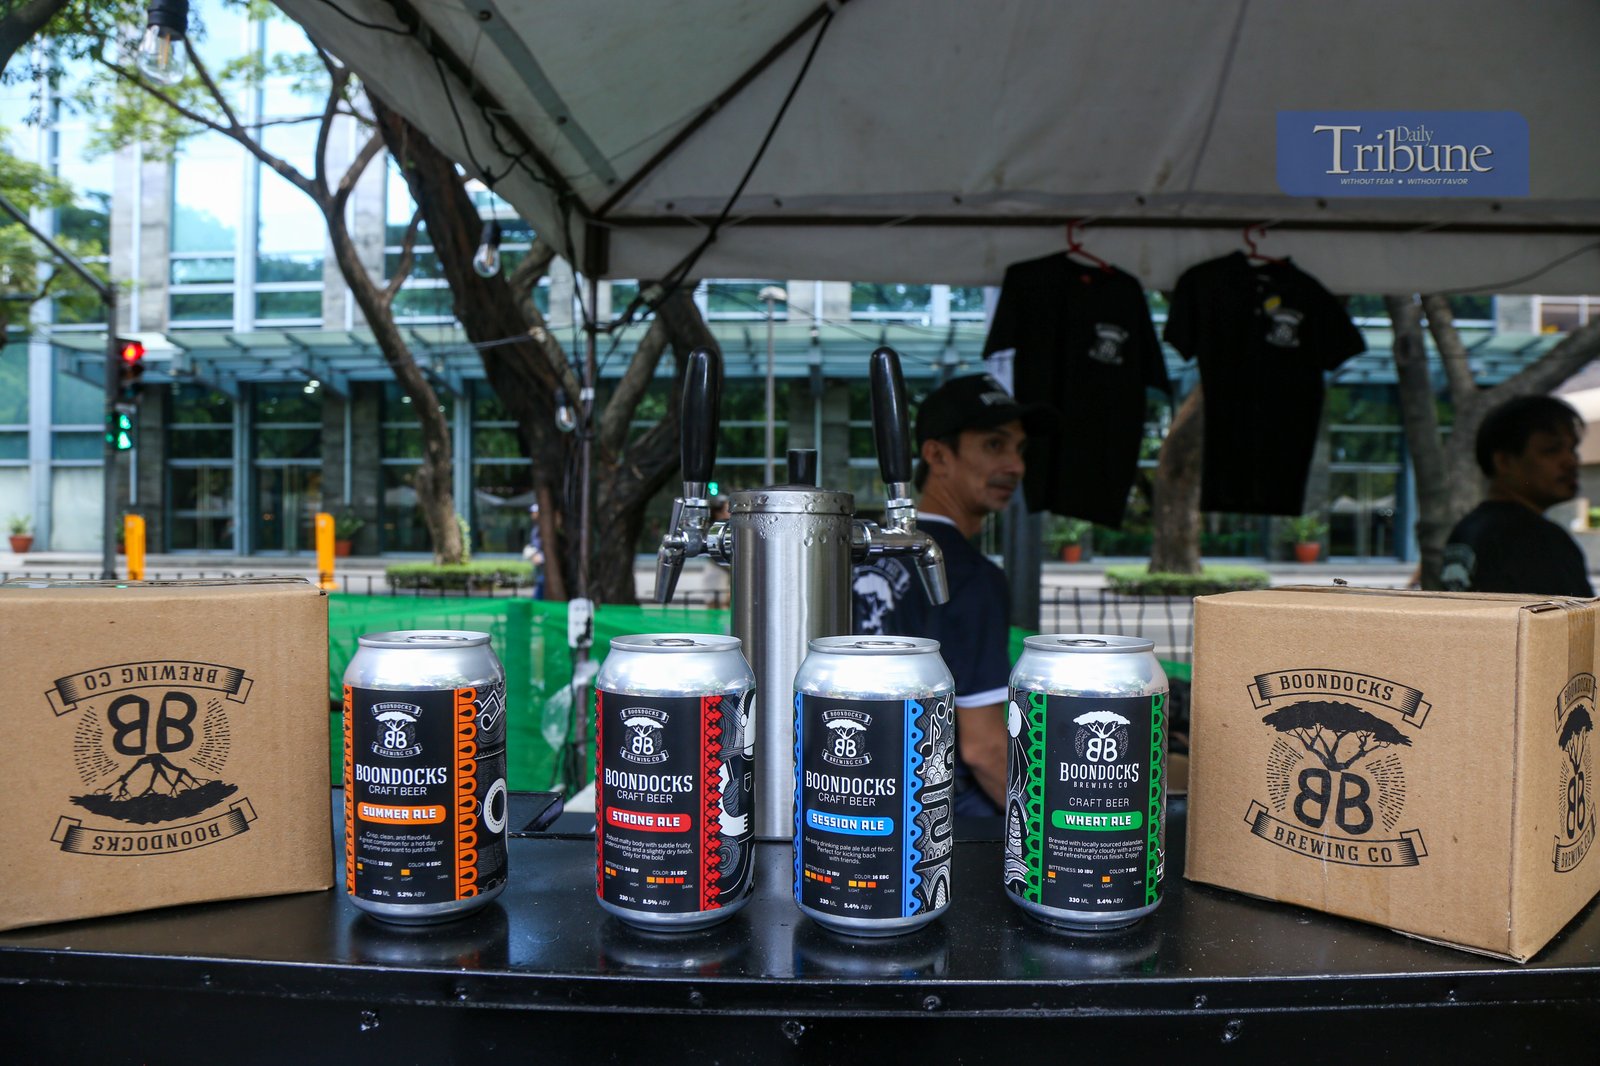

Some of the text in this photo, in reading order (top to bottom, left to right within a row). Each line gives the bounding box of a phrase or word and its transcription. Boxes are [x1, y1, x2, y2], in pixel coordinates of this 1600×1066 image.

[84, 665, 218, 691] BREWING CO
[1279, 673, 1394, 701] BOONDOCKS
[355, 764, 447, 785] BOONDOCKS
[1059, 762, 1139, 783] BOONDOCKS
[605, 768, 693, 793] BOONDOCKS
[805, 770, 896, 796] BOONDOCKS
[1073, 781, 1113, 789] BREWING
[368, 785, 427, 796] CRAFT BEER
[617, 789, 673, 804] CRAFT BEER
[818, 792, 876, 807] CRAFT BEER
[1069, 797, 1130, 808] CRAFT BEER
[363, 806, 437, 820] SUMMER ALE
[612, 811, 680, 827] STRONG ALE
[1065, 814, 1132, 826] WHEAT ALE
[812, 813, 885, 831] SESSION ALE
[92, 823, 221, 851] BOONDOCKS
[619, 838, 631, 846] malty
[632, 840, 644, 848] body
[1048, 836, 1068, 845] Brewed
[1273, 826, 1393, 862] BREWING CO
[816, 846, 834, 855] Perfect
[842, 851, 862, 859] kicking
[820, 841, 839, 850] drinking
[622, 851, 633, 859] Only
[1064, 852, 1092, 860] refreshing
